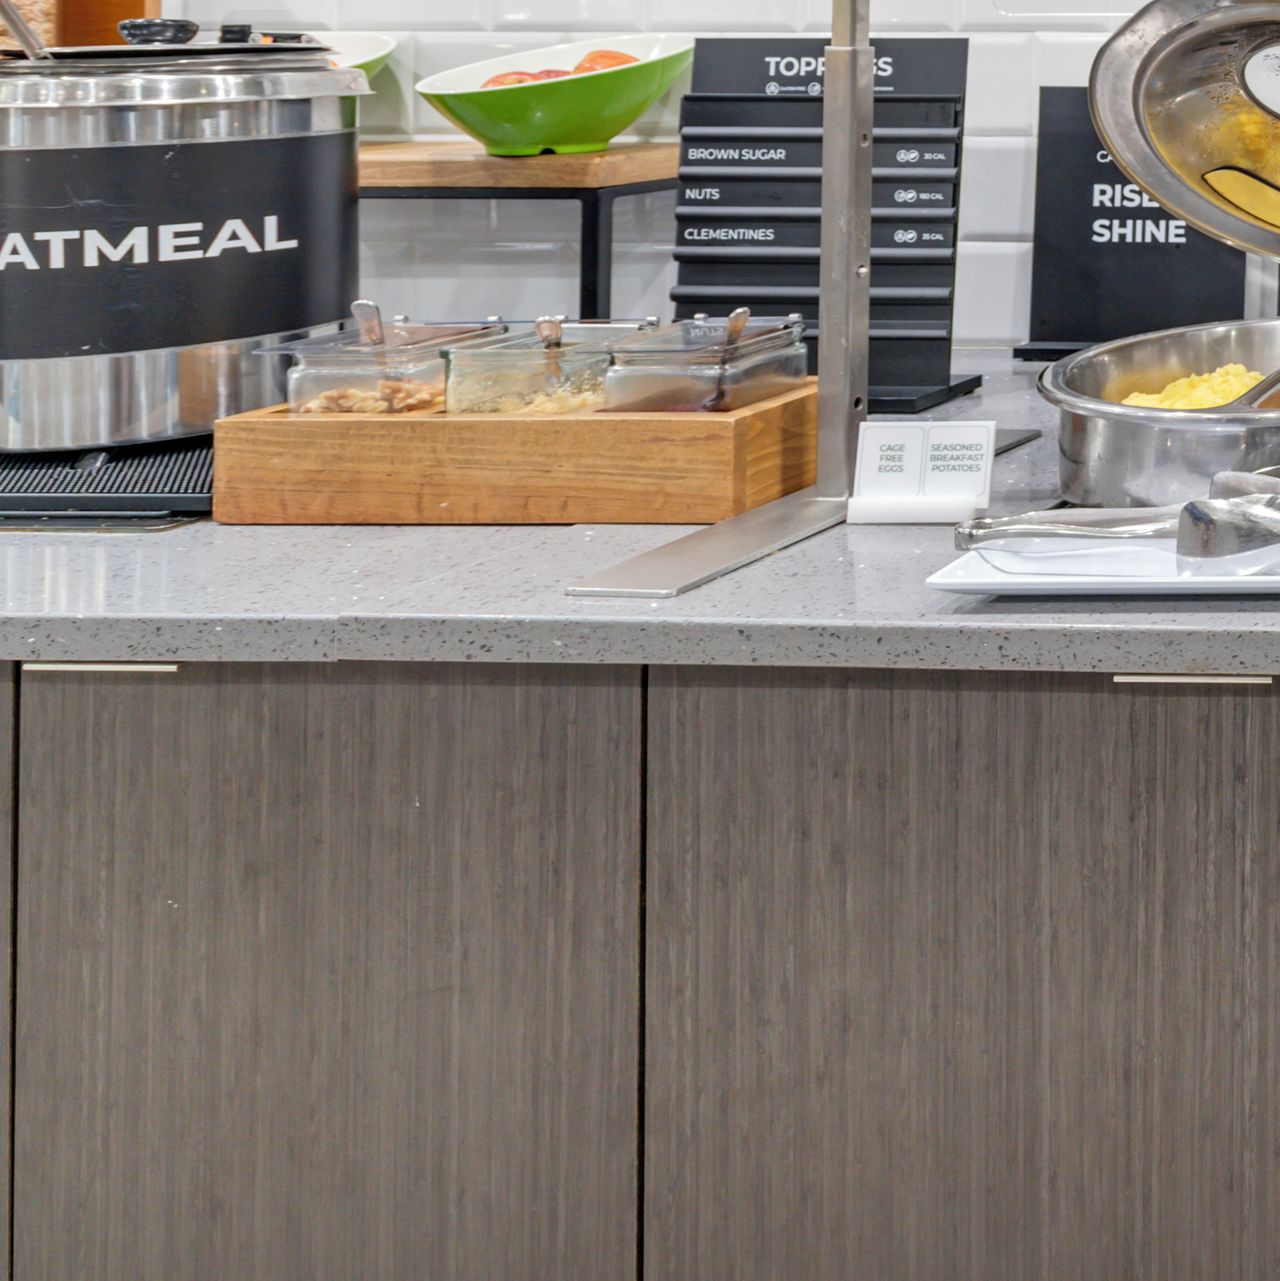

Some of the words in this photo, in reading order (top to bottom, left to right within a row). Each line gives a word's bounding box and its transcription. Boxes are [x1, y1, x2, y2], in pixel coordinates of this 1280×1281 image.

[765, 57, 893, 76] TOPS
[688, 149, 739, 159] BROWN
[742, 149, 786, 160] SUGAR
[686, 189, 720, 199] NUTS
[684, 229, 774, 240] CLEMENTINES
[1092, 219, 1187, 243] SHINE
[880, 444, 905, 452] CAGE
[931, 444, 983, 452] SEASONED
[930, 454, 984, 462] BREAKFAST
[932, 464, 981, 472] POTATOES
